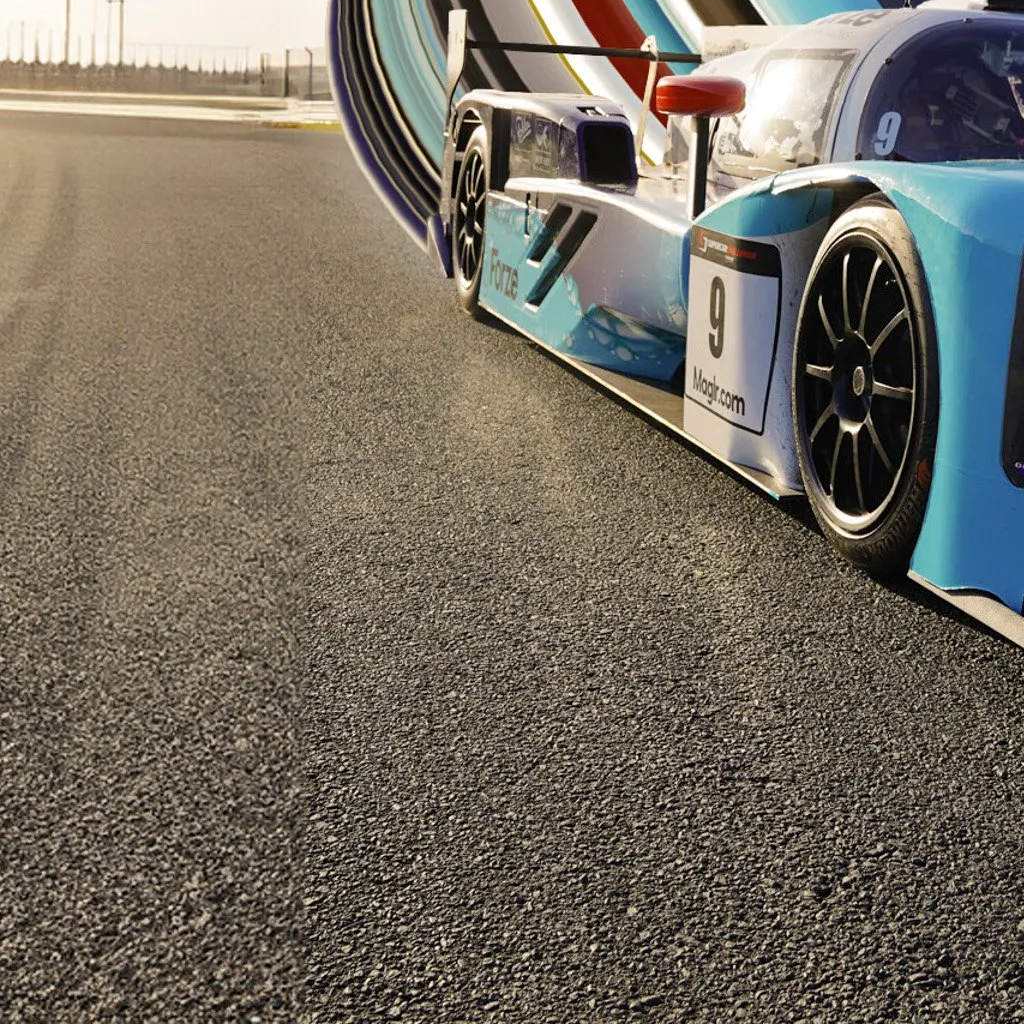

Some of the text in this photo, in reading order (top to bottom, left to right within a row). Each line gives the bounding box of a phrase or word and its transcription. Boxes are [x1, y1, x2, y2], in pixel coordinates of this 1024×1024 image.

[874, 111, 902, 156] 9
[490, 247, 518, 301] Forze
[708, 275, 726, 359] 9
[693, 365, 746, 416] Maglr.com
